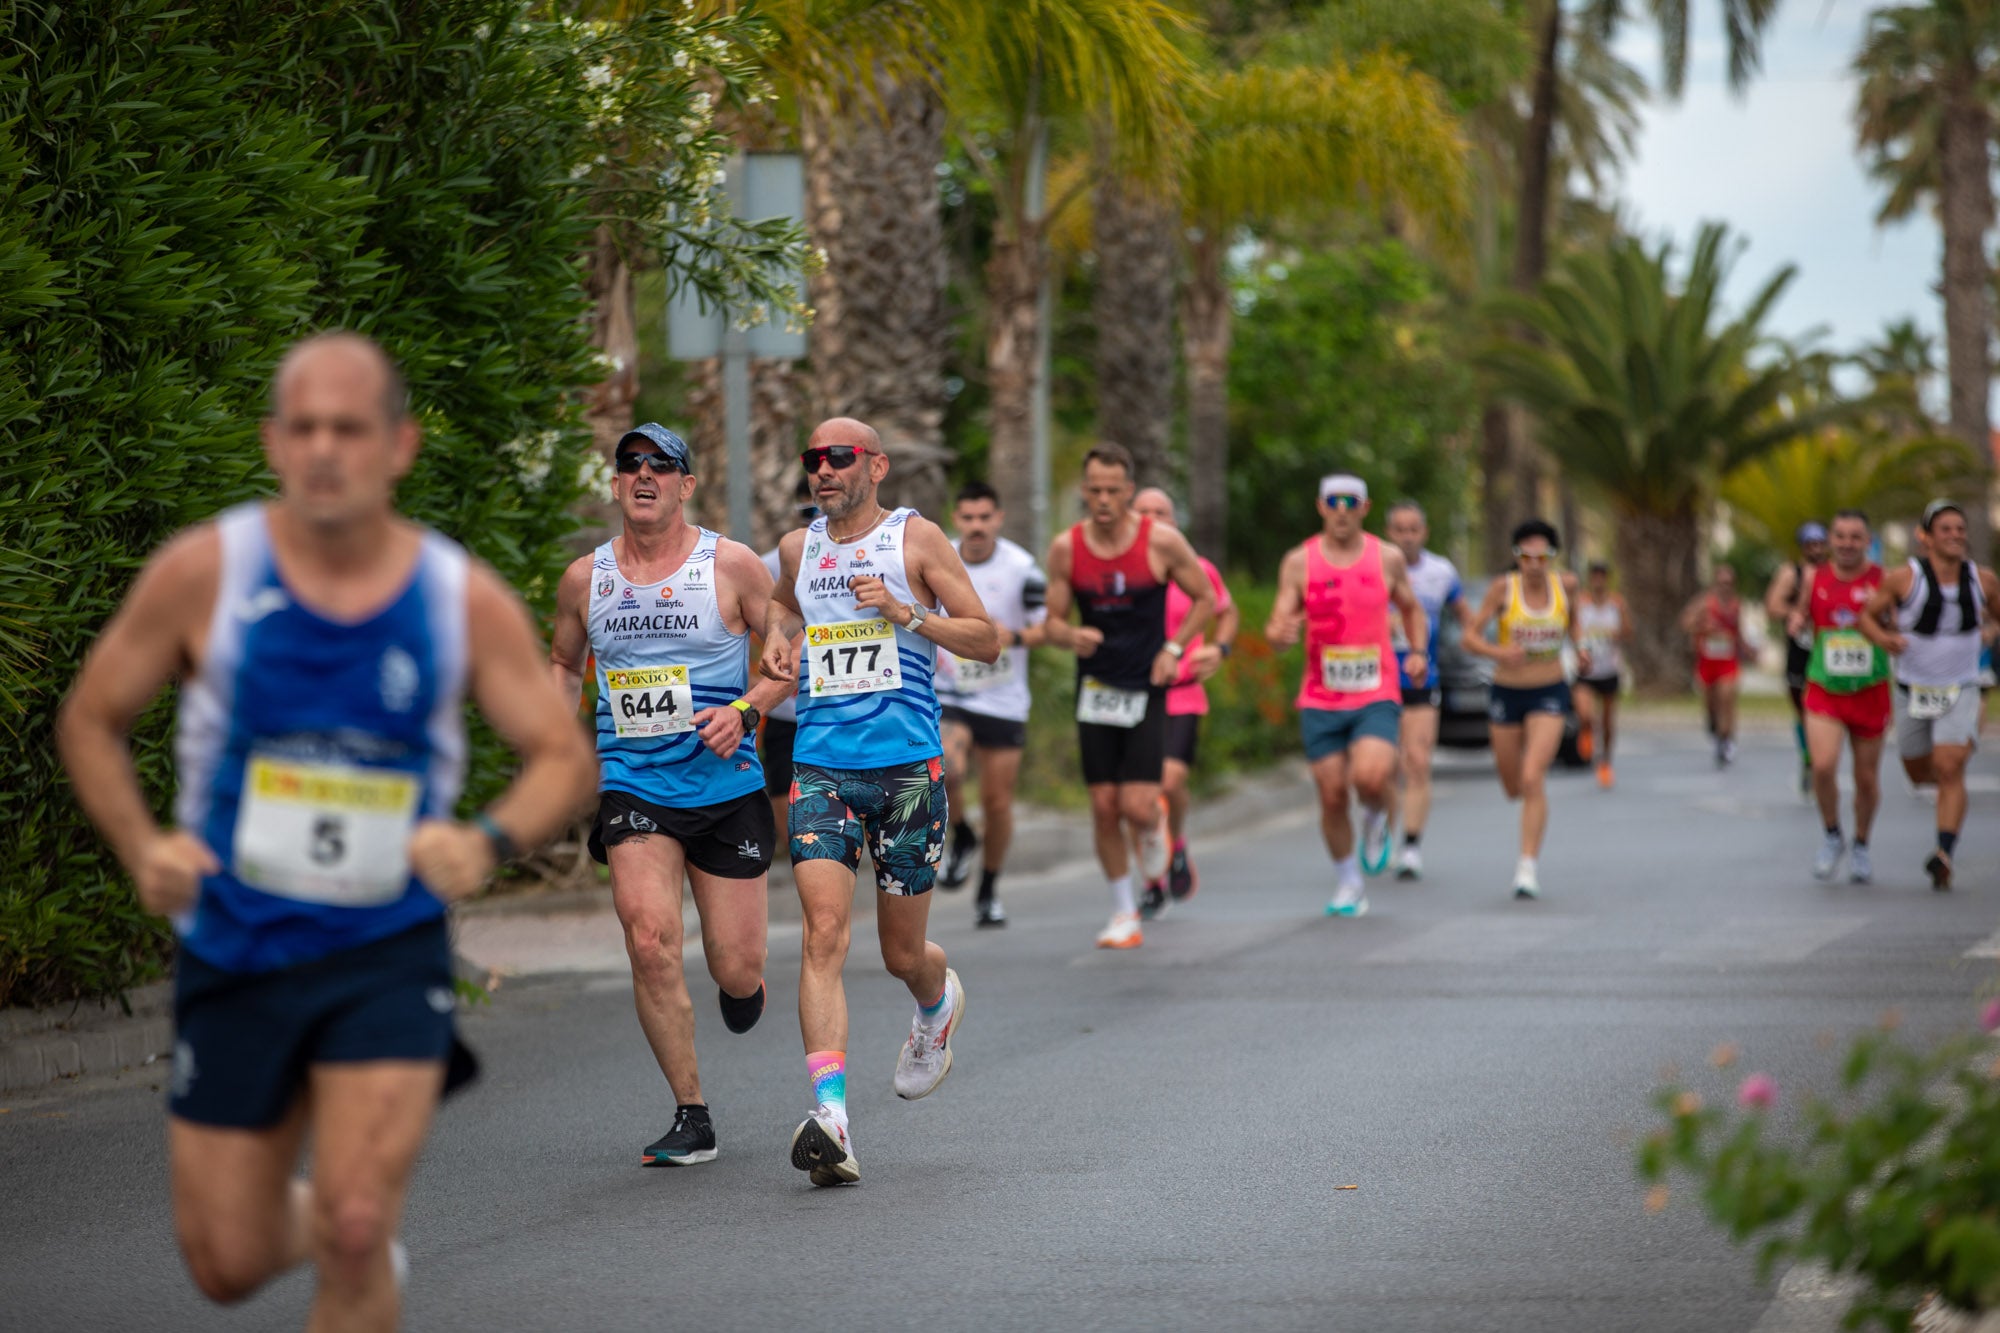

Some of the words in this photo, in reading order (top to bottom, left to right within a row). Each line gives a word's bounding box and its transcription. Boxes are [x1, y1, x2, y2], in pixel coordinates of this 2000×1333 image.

[603, 614, 699, 633] MARACENA
[821, 644, 881, 676] 177
[620, 690, 677, 720] 644
[310, 815, 346, 868] 5
